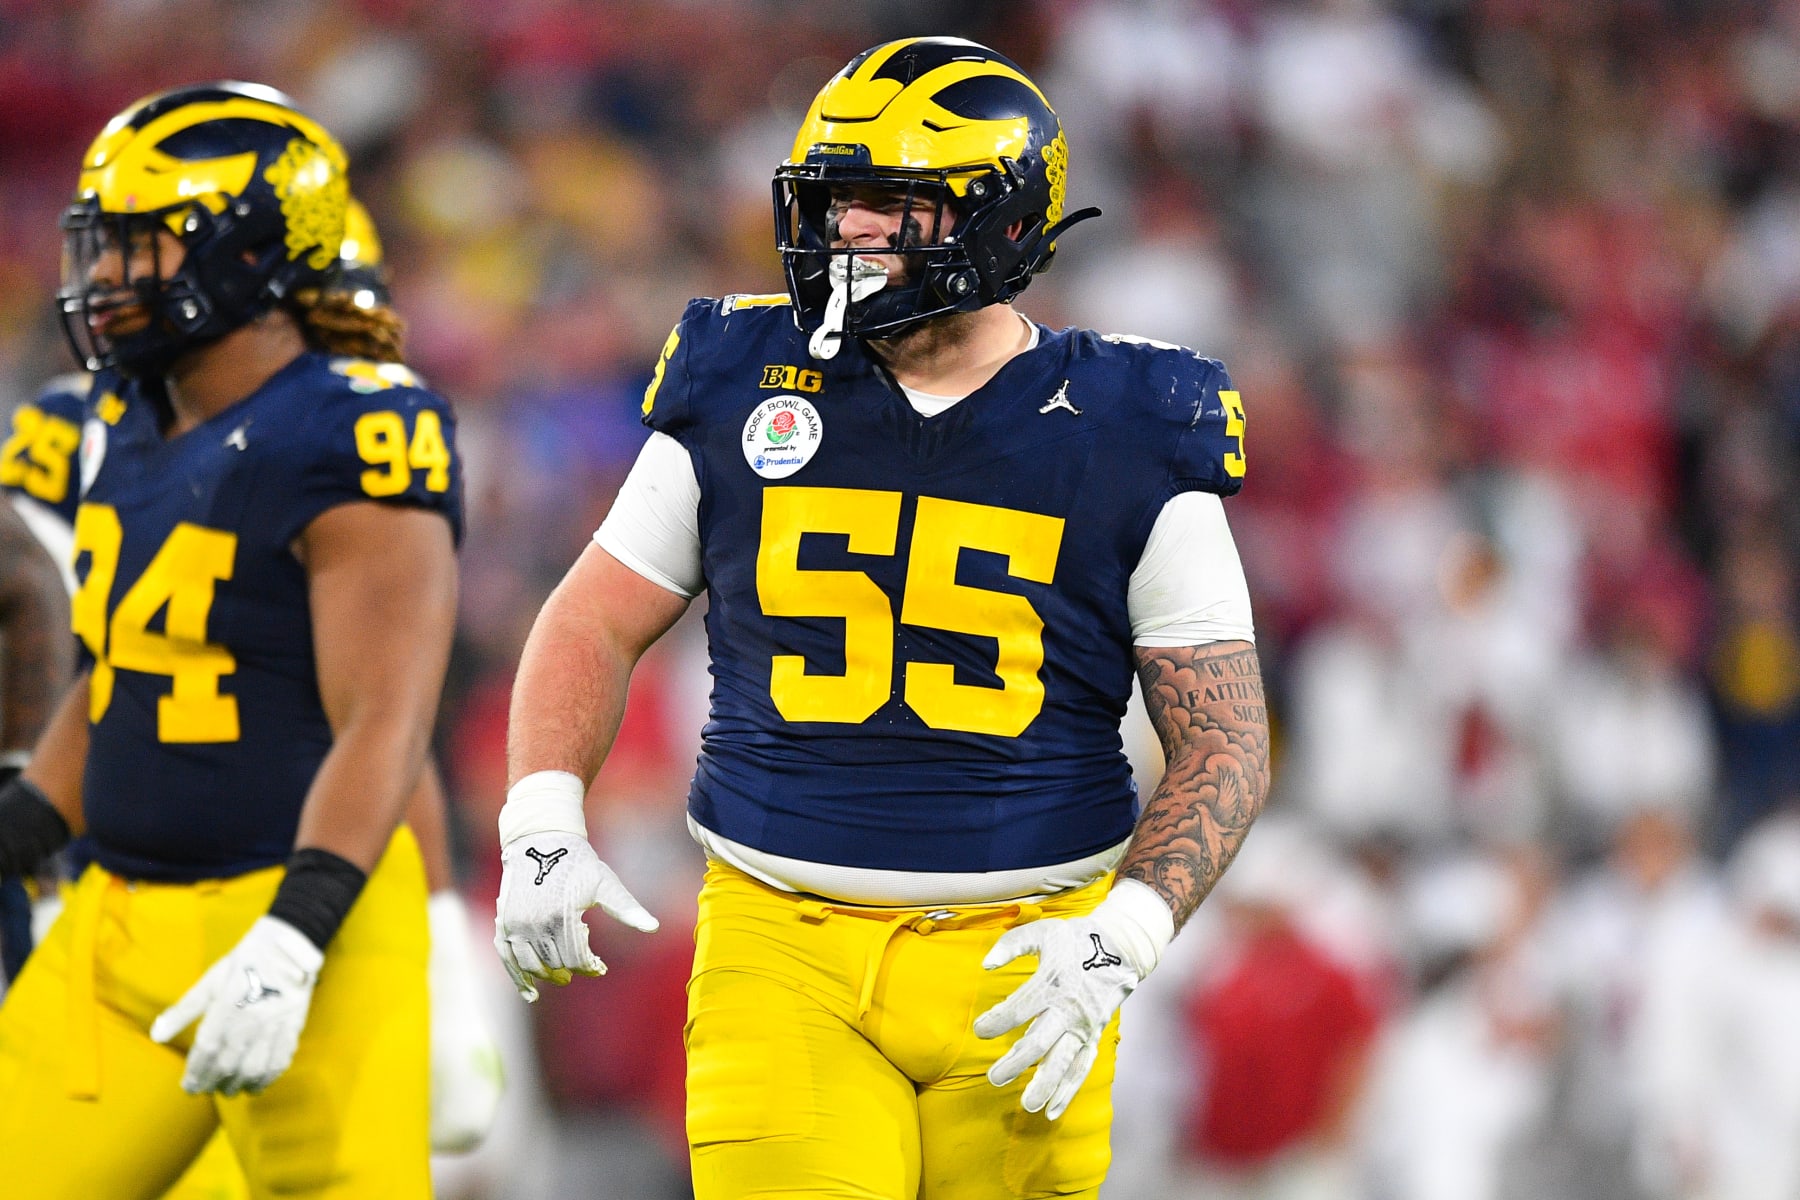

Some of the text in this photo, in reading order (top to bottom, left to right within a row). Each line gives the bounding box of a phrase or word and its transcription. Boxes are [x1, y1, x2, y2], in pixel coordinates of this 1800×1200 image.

[353, 410, 450, 497] 94
[747, 399, 818, 442] ROSE BOWL GAME
[766, 457, 804, 466] Prudential
[1217, 390, 1246, 478] 5
[71, 503, 240, 743] 94
[756, 486, 1066, 738] 55
[1233, 702, 1268, 727] SIGH
